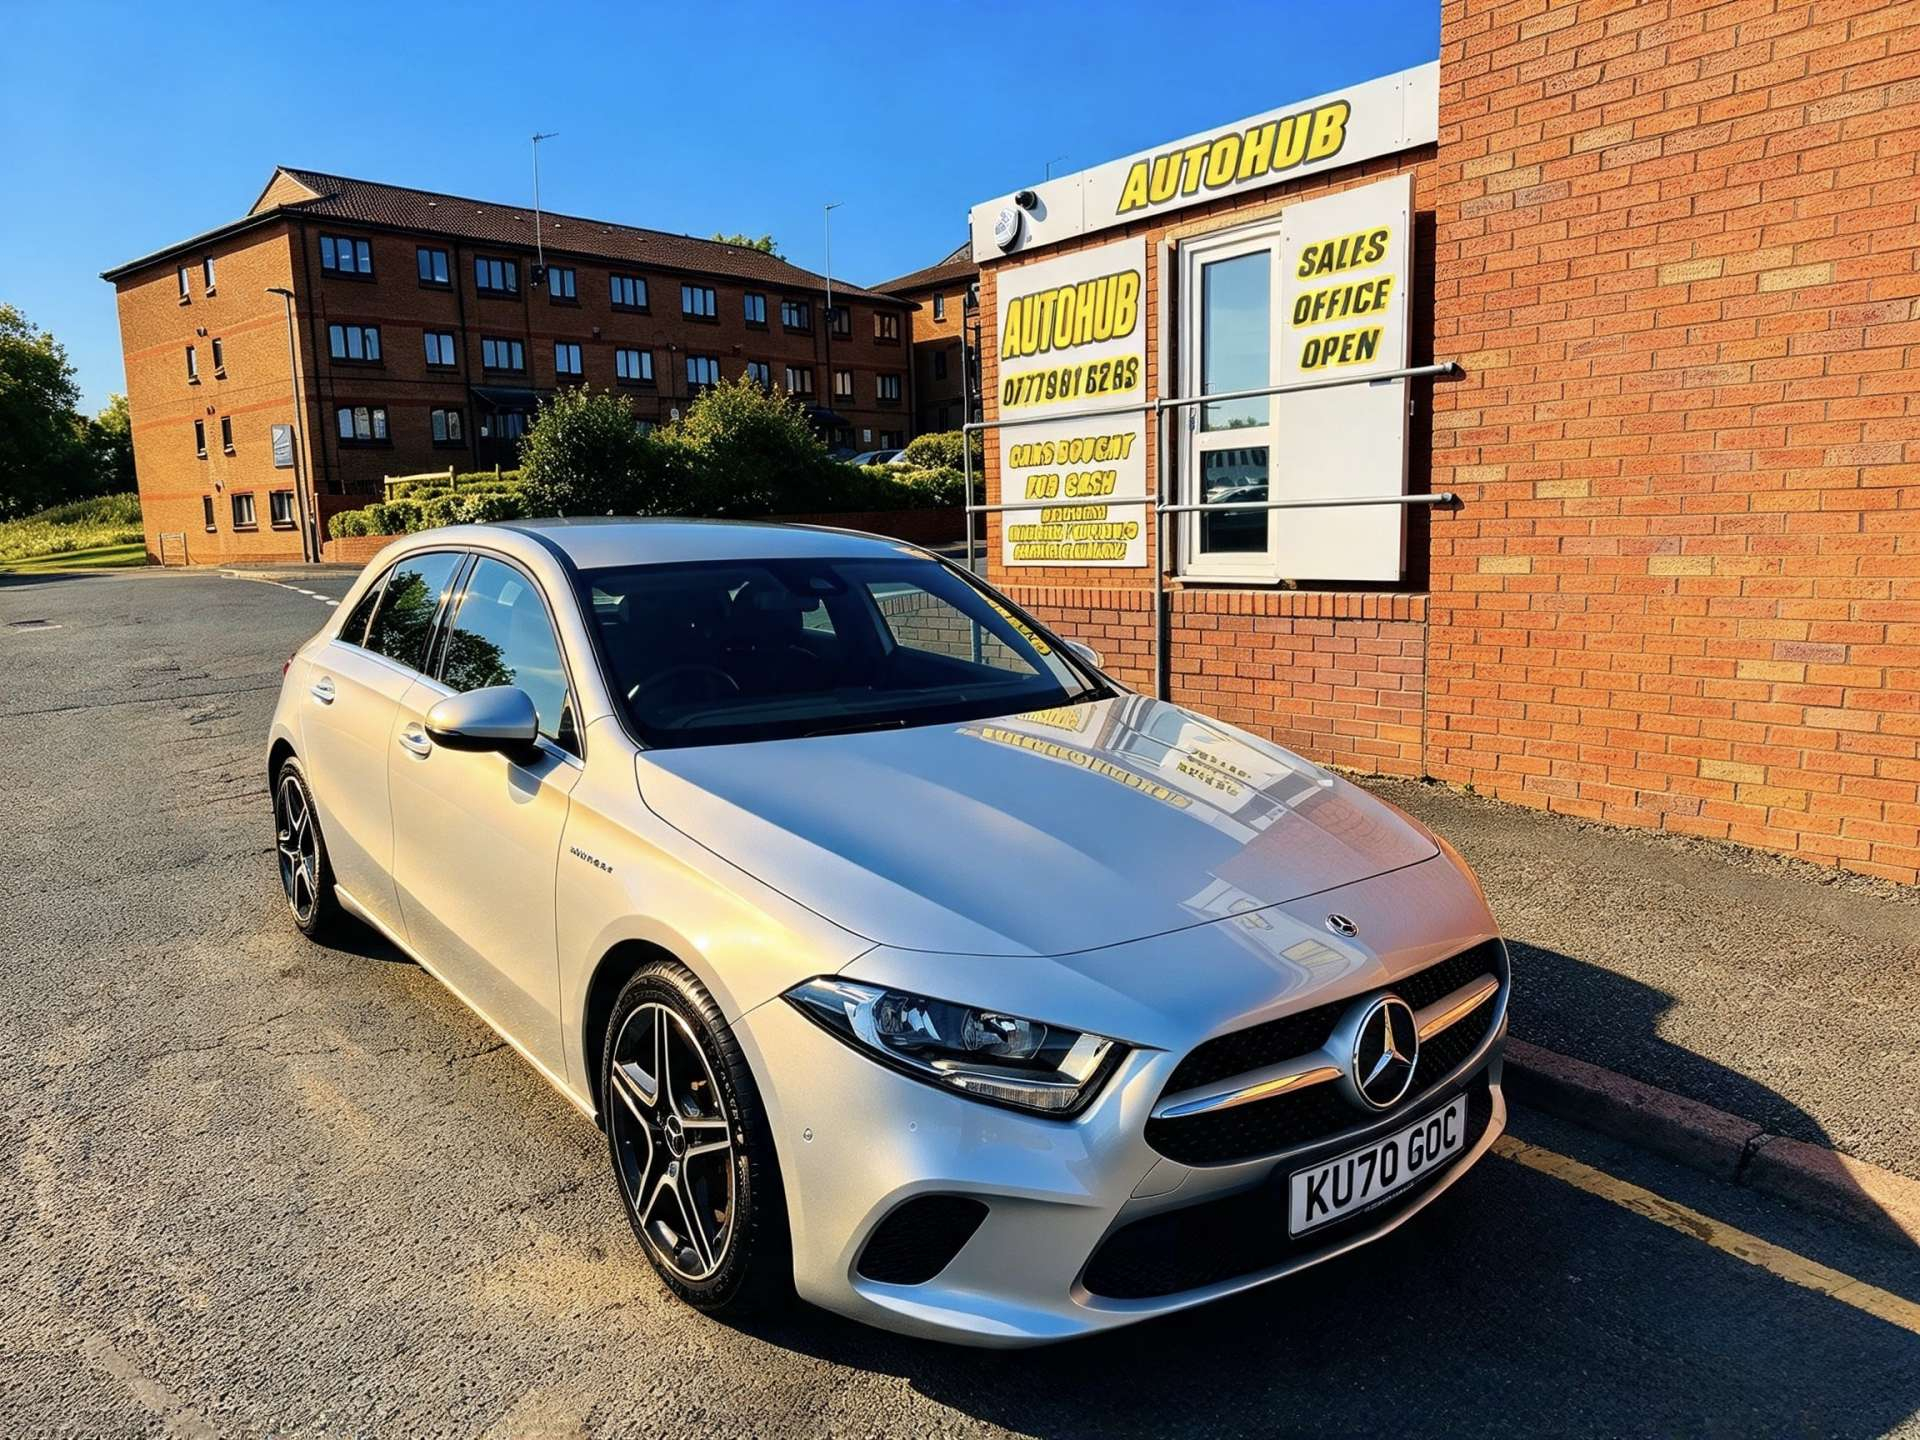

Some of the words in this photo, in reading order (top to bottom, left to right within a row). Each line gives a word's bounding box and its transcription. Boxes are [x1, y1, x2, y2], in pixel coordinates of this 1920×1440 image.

[1116, 99, 1351, 215] AUTOHUB
[1298, 229, 1388, 278] SALES
[1001, 269, 1141, 361] AUTOHUB
[1293, 278, 1391, 325] OFFICE
[1301, 329, 1380, 369] OPEN
[1306, 1141, 1399, 1222] KU70
[1407, 1106, 1457, 1172] GOC
